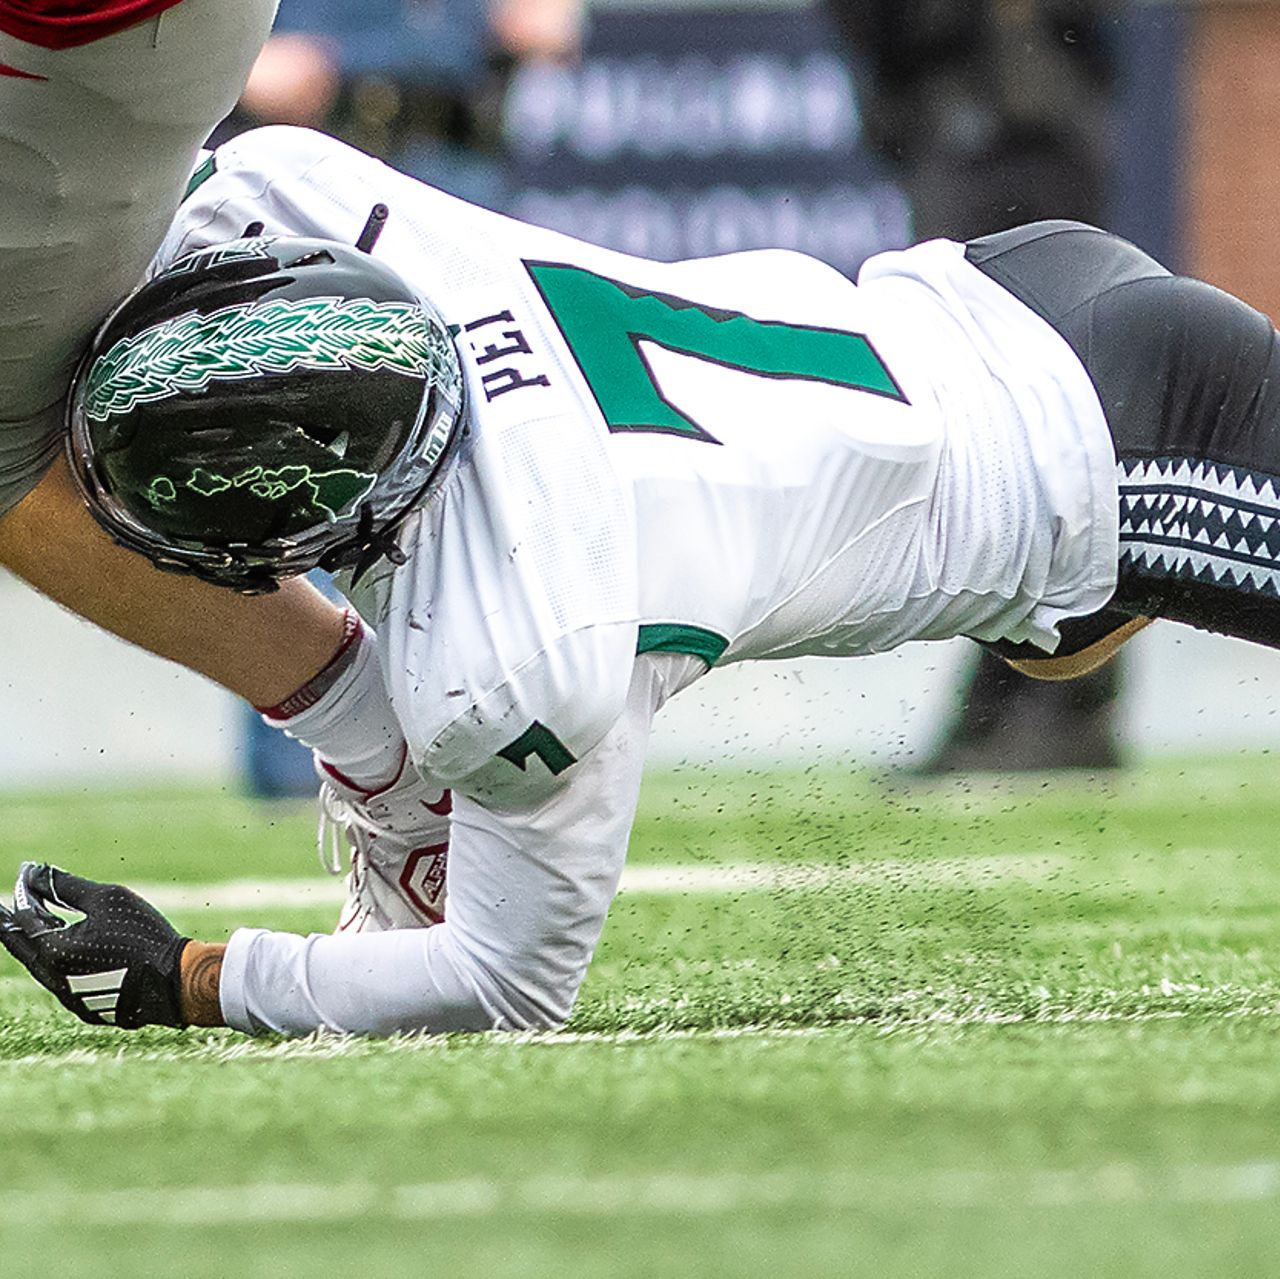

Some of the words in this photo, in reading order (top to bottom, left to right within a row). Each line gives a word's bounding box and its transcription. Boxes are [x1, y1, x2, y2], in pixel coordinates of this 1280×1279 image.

[464, 310, 551, 403] PEI
[521, 259, 912, 446] 7
[495, 719, 578, 776] 7
